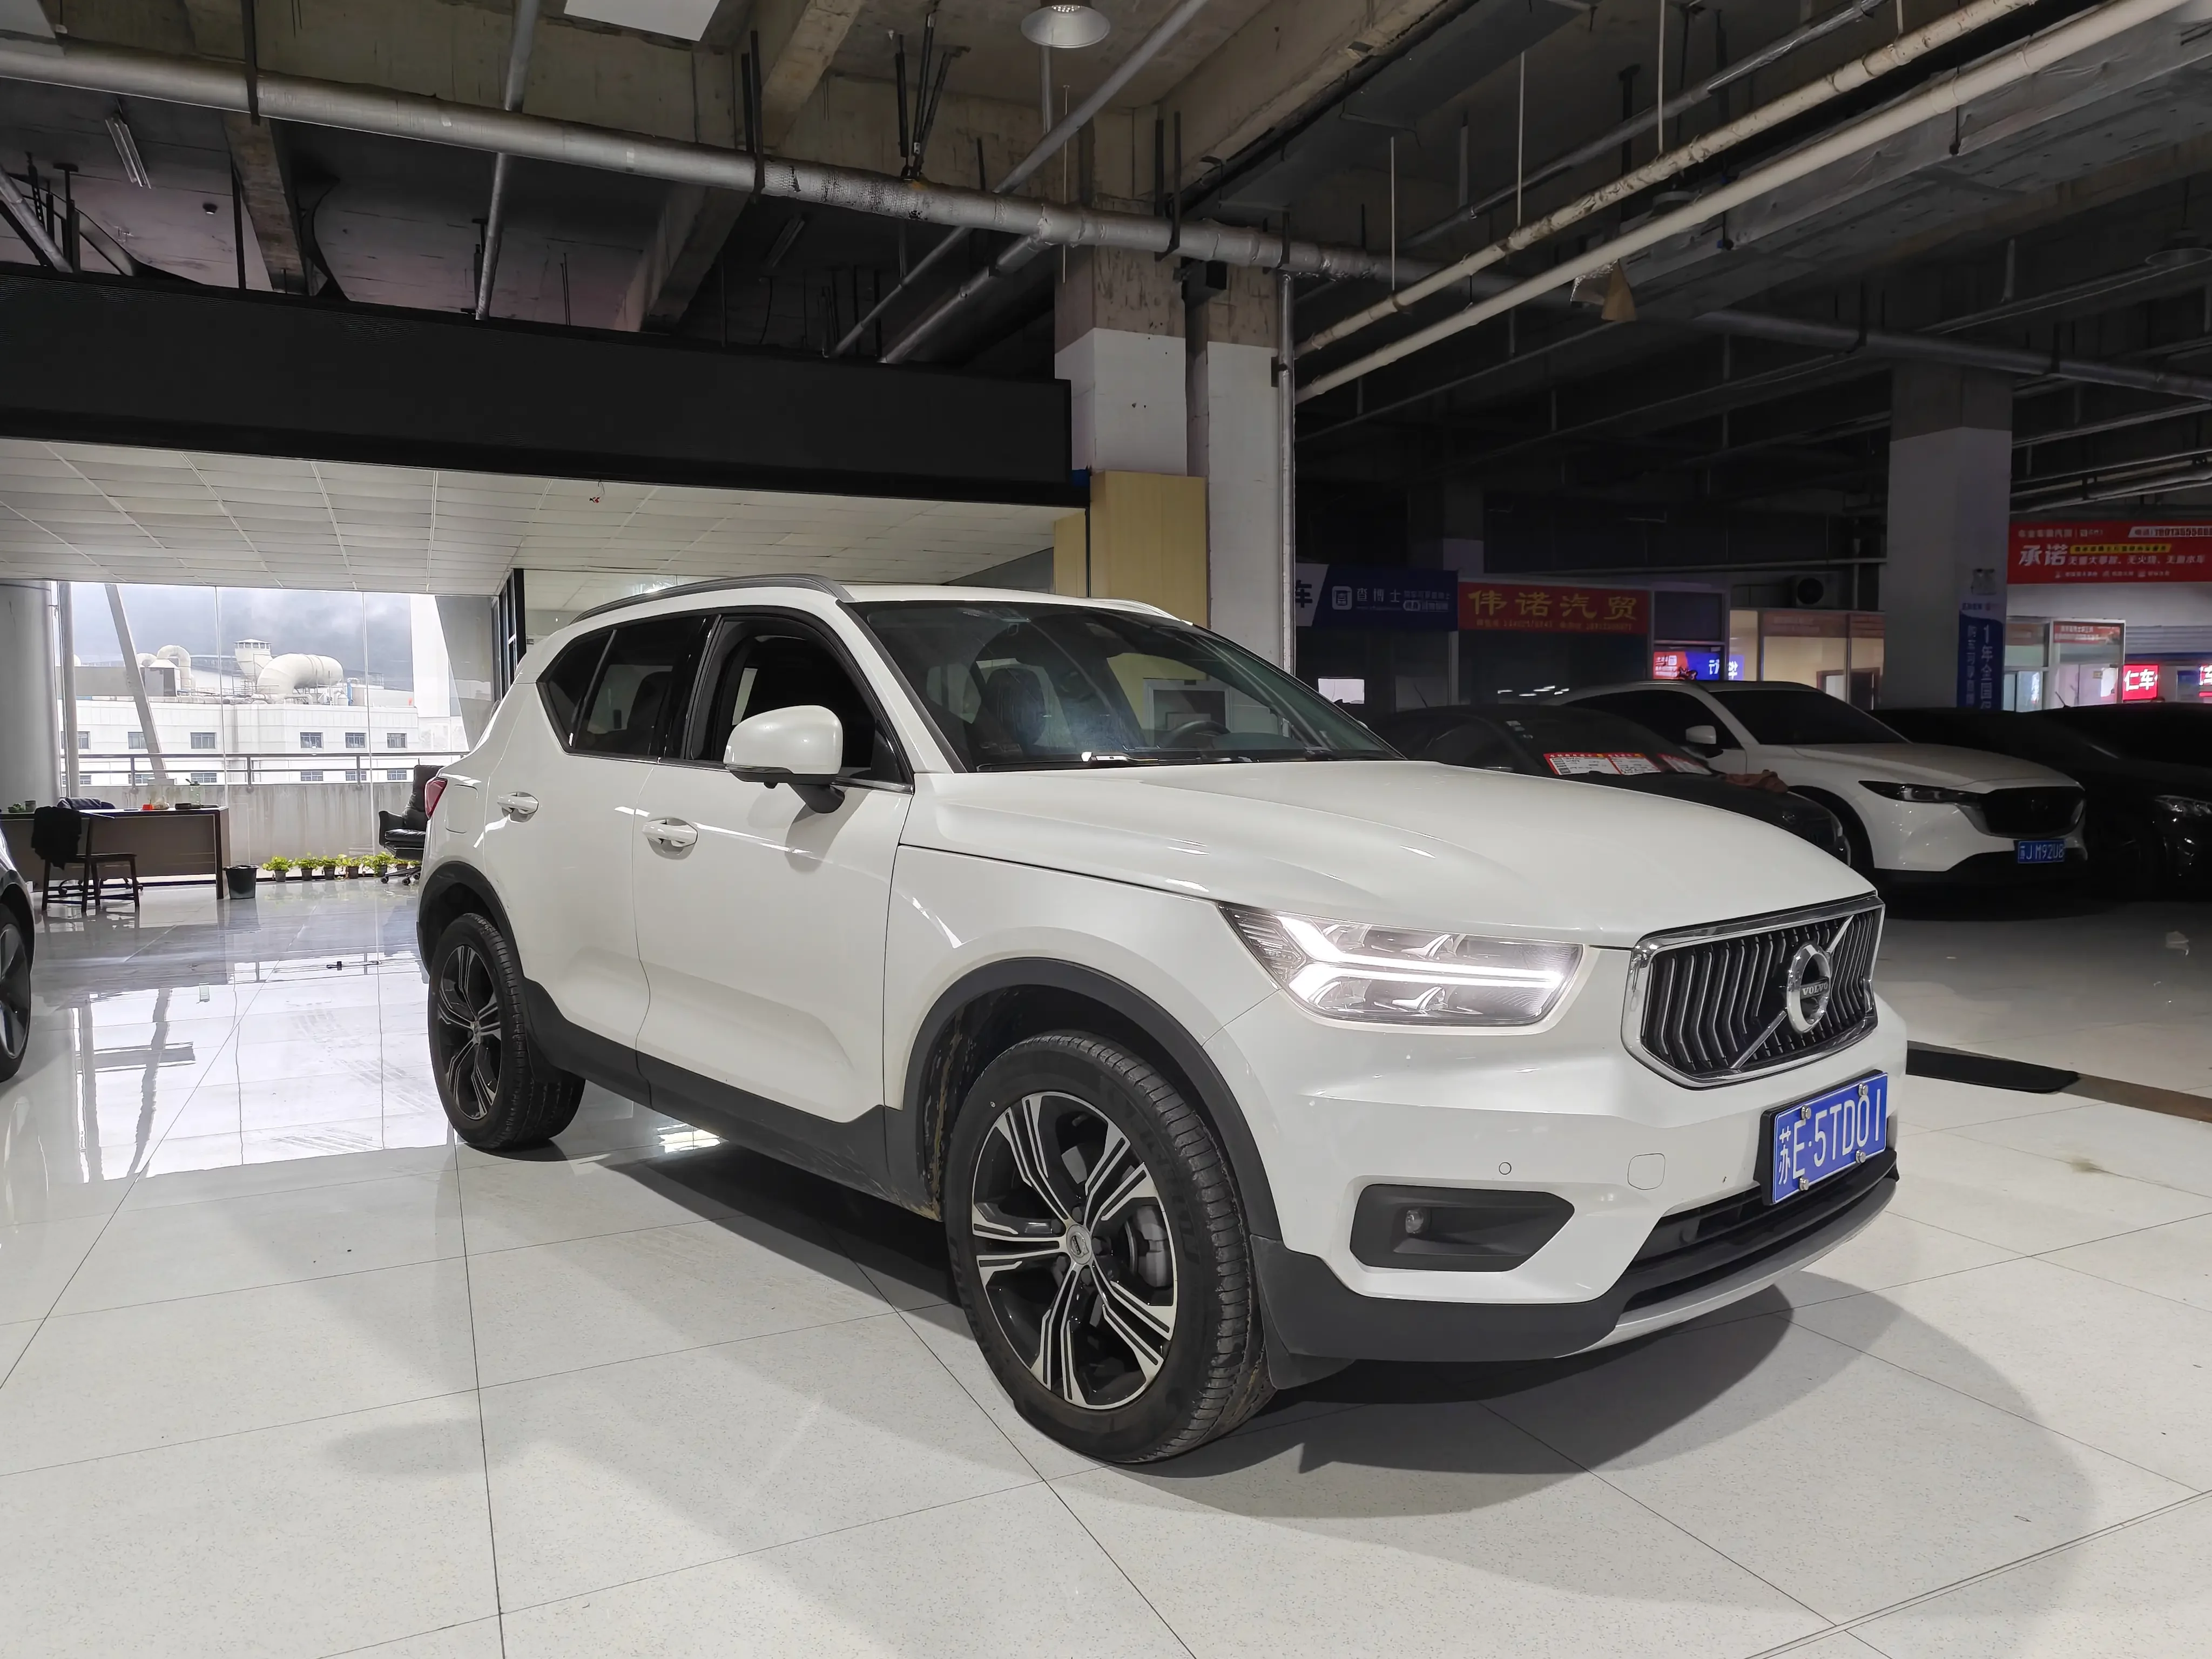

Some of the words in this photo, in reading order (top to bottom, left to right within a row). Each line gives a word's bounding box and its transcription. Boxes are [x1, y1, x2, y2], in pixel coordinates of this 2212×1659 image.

[2019, 543, 2068, 567] 承诺
[1357, 588, 1402, 603] 查博士
[1468, 589, 1638, 621] 伟诺汽贸
[2123, 669, 2158, 692] 仁车
[1802, 982, 1828, 996] VOLVO
